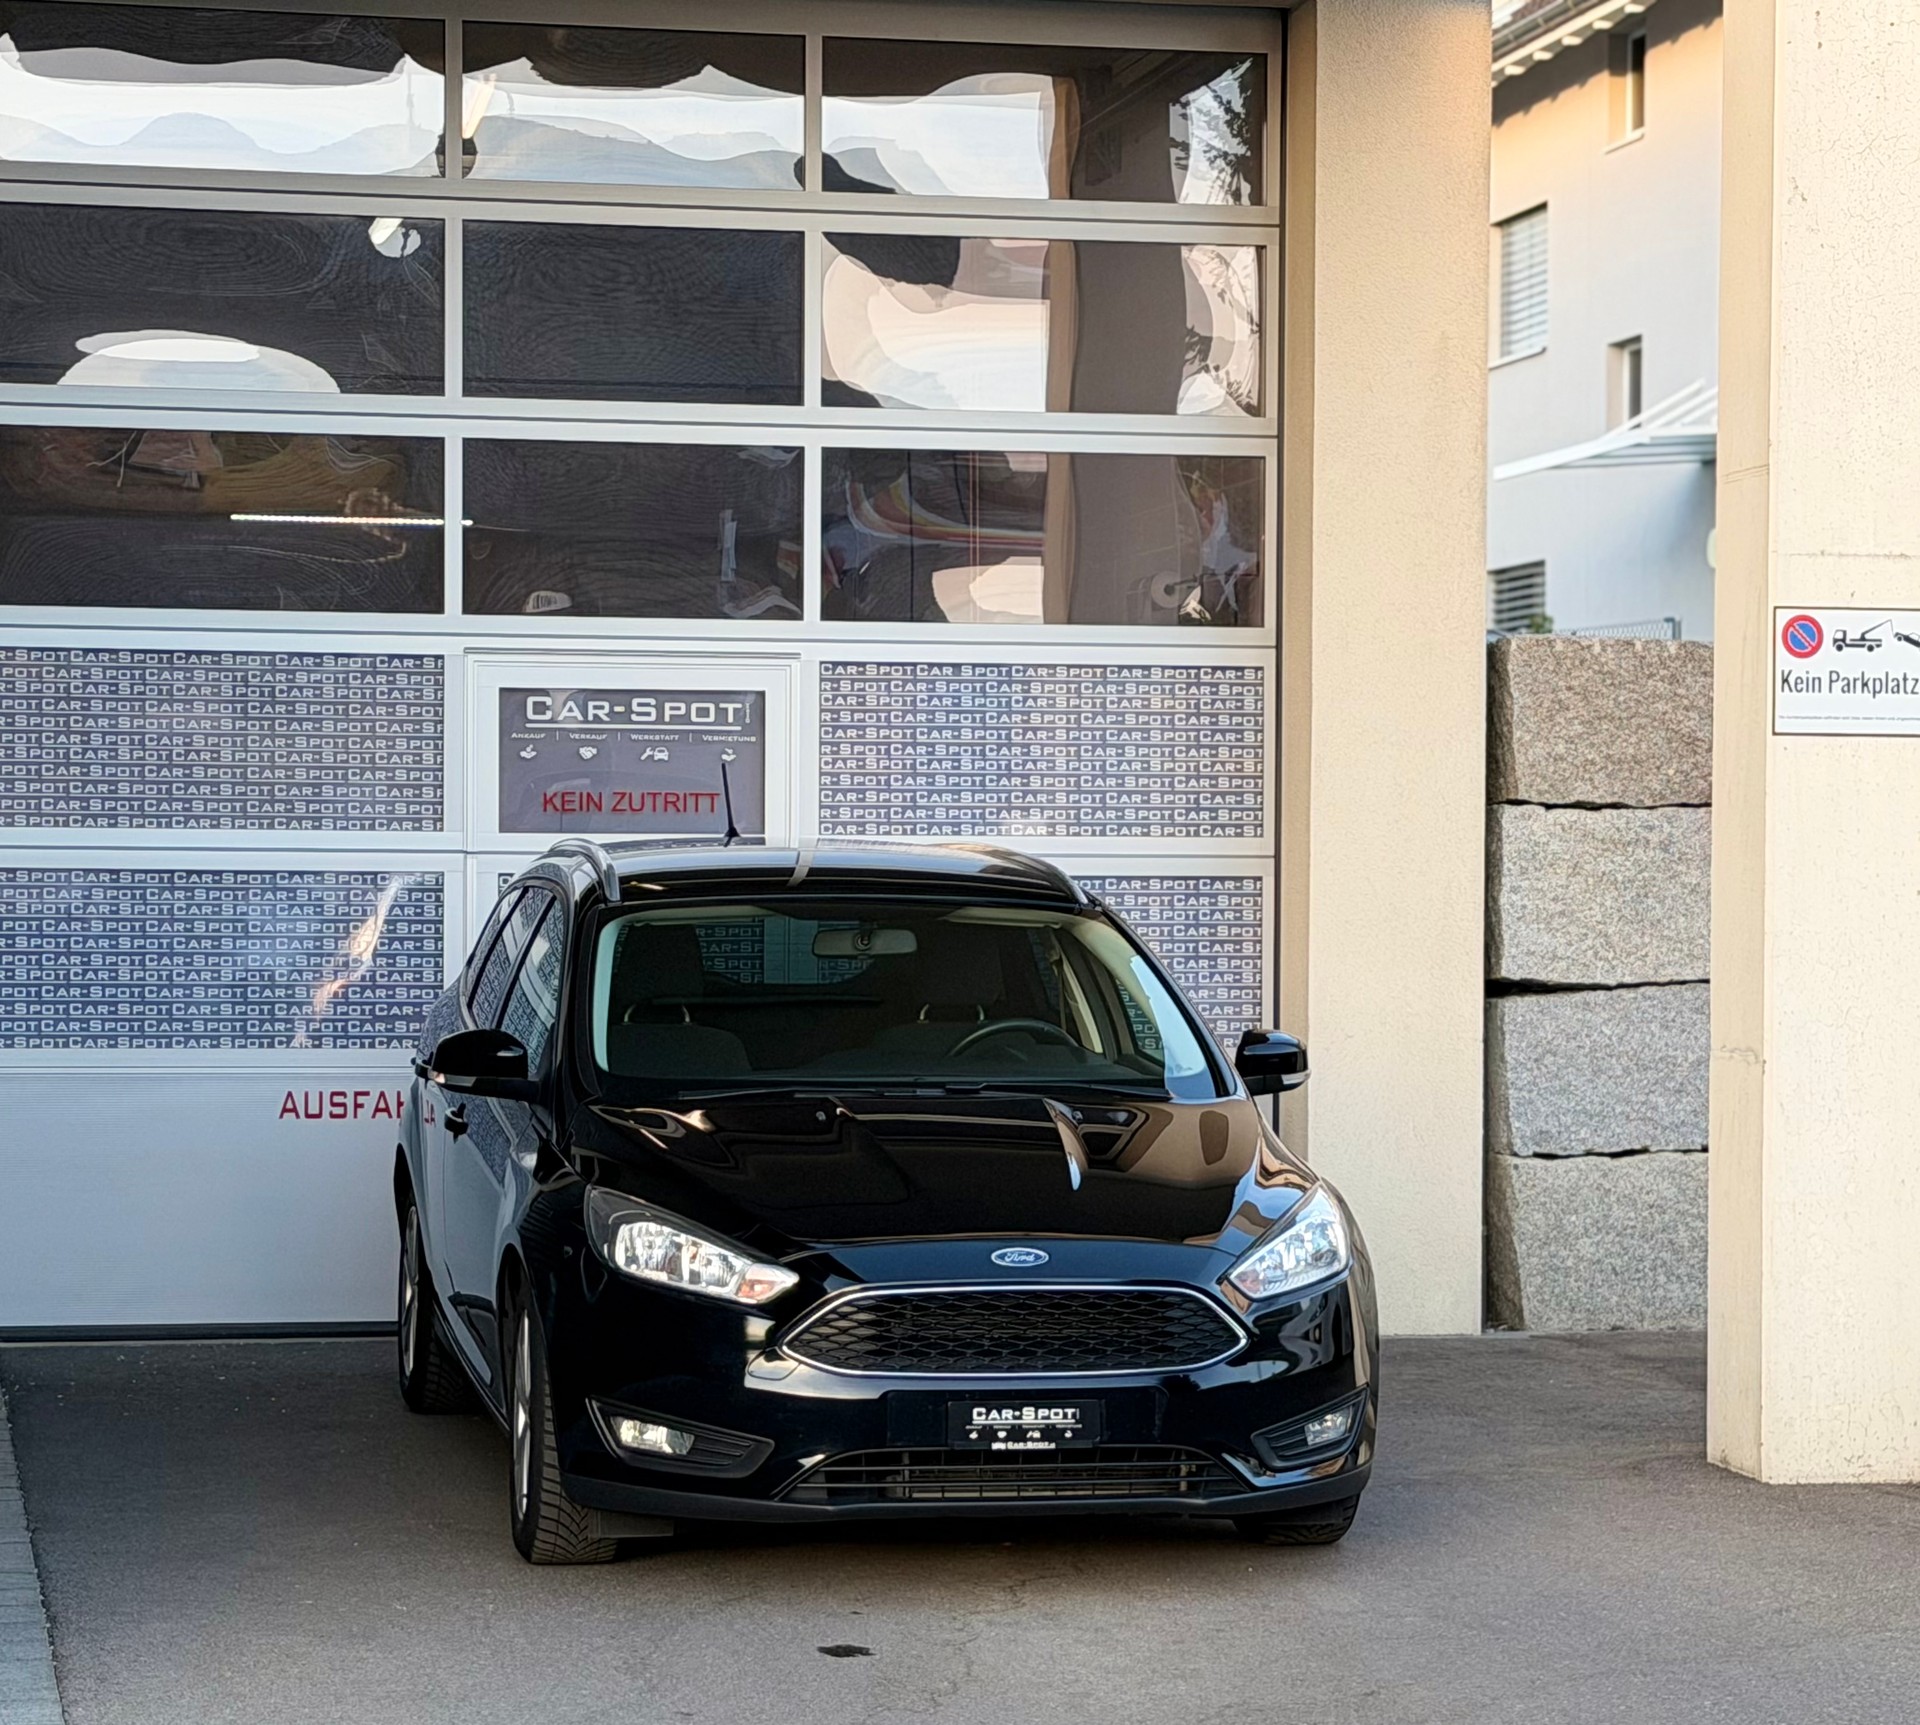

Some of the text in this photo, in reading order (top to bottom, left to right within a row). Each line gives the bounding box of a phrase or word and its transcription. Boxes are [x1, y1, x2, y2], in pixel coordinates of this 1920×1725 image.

[70, 649, 170, 664] CAR-SPOT
[173, 651, 271, 665] CAR-SPOT
[274, 653, 372, 667] CAR-SPOT
[42, 666, 142, 680] CAR-SPOT
[145, 668, 244, 682] CAR-SPOT
[247, 669, 345, 683] CAR-SPOT
[820, 663, 914, 676] CAR-SPOT
[1011, 665, 1103, 678] CAR-SPOT
[1105, 666, 1197, 679] CAR-SPOT
[69, 681, 170, 695] CAR-SPOT
[172, 683, 271, 697] CAR-SPOT
[274, 685, 372, 699] CAR-SPOT
[890, 680, 983, 693] CAR-SPOT
[985, 681, 1078, 694] CAR-SPOT
[1080, 682, 1172, 695] CAR-SPOT
[1781, 669, 1920, 699] Kein Parkplatz
[41, 698, 142, 712] CAR-SPOT
[145, 700, 244, 713] CAR-SPOT
[246, 701, 345, 715] CAR-SPOT
[820, 694, 914, 706] CAR-SPOT
[916, 695, 1009, 707] CAR-SPOT
[1011, 696, 1103, 708] CAR-SPOT
[1105, 696, 1197, 709] CAR-SPOT
[526, 695, 743, 724] CAR-SPOT
[69, 715, 169, 729] CAR-SPOT
[172, 717, 271, 730] CAR-SPOT
[274, 718, 372, 732] CAR-SPOT
[890, 711, 983, 723] CAR-SPOT
[985, 712, 1078, 724] CAR-SPOT
[41, 732, 142, 745] CAR-SPOT
[144, 733, 244, 747] CAR-SPOT
[246, 735, 345, 748] CAR-SPOT
[820, 726, 914, 739] CAR-SPOT
[916, 727, 1009, 740] CAR-SPOT
[1011, 728, 1103, 741] CAR-SPOT
[1105, 729, 1197, 741] CAR-SPOT
[69, 747, 169, 761] CAR-SPOT
[171, 748, 271, 762] CAR-SPOT
[274, 750, 372, 764] CAR-SPOT
[890, 743, 983, 756] CAR-SPOT
[985, 744, 1078, 757] CAR-SPOT
[1080, 745, 1172, 757] CAR-SPOT
[41, 763, 142, 777] CAR-SPOT
[144, 765, 244, 778] CAR-SPOT
[246, 766, 345, 780] CAR-SPOT
[820, 757, 914, 770] CAR-SPOT
[916, 758, 1009, 770] CAR-SPOT
[1011, 759, 1103, 771] CAR-SPOT
[1105, 759, 1197, 772] CAR-SPOT
[890, 774, 983, 786] CAR-SPOT
[985, 774, 1078, 787] CAR-SPOT
[1080, 775, 1172, 788] CAR-SPOT
[69, 781, 169, 794] CAR-SPOT
[171, 782, 271, 796] CAR-SPOT
[273, 783, 372, 797] CAR-SPOT
[542, 791, 721, 814] KEIN ZUTRITT
[820, 790, 914, 802] CAR-SPOT
[916, 790, 1009, 803] CAR-SPOT
[1011, 791, 1103, 803] CAR-SPOT
[1105, 792, 1197, 804] CAR-SPOT
[40, 797, 141, 811] CAR-SPOT
[144, 799, 243, 812] CAR-SPOT
[246, 800, 345, 813] CAR-SPOT
[890, 806, 983, 819] CAR-SPOT
[985, 807, 1078, 819] CAR-SPOT
[1080, 808, 1172, 820] CAR-SPOT
[68, 815, 169, 828] CAR-SPOT
[171, 816, 271, 829] CAR-SPOT
[273, 817, 372, 830] CAR-SPOT
[820, 822, 914, 835] CAR-SPOT
[916, 823, 1009, 835] CAR-SPOT
[1011, 823, 1103, 836] CAR-SPOT
[1105, 824, 1197, 836] CAR-SPOT
[70, 870, 373, 885] CAR-SPOT CAR-SPOT CAR-SPOT
[1105, 878, 1198, 890] CAR-SPOT
[42, 886, 346, 901] CAR-SPOT CAR-SPOT CAR-SPOT
[70, 902, 373, 916] CAR-SPOT CAR-SPOT CAR-SPOT
[42, 919, 346, 933] CAR-SPOT CAR-SPOT CAR-SPOT
[70, 936, 170, 949] CAR-SPOT
[172, 937, 272, 949] CAR-SPOT
[41, 953, 142, 966] CAR-SPOT
[145, 953, 244, 966] CAR-SPOT
[69, 968, 170, 981] CAR-SPOT
[172, 968, 271, 981] CAR-SPOT
[41, 985, 244, 998] CAR-SPOT CAR-SPOT
[69, 1002, 169, 1015] CAR-SPOT
[172, 1002, 271, 1015] CAR-SPOT
[41, 1019, 345, 1032] CAR-SPOT CAR-SPOT CAR-SPOT
[69, 1036, 169, 1048] CAR-SPOT
[171, 1036, 271, 1048] CAR-SPOT
[972, 1407, 1076, 1420] CAR-SPOT
